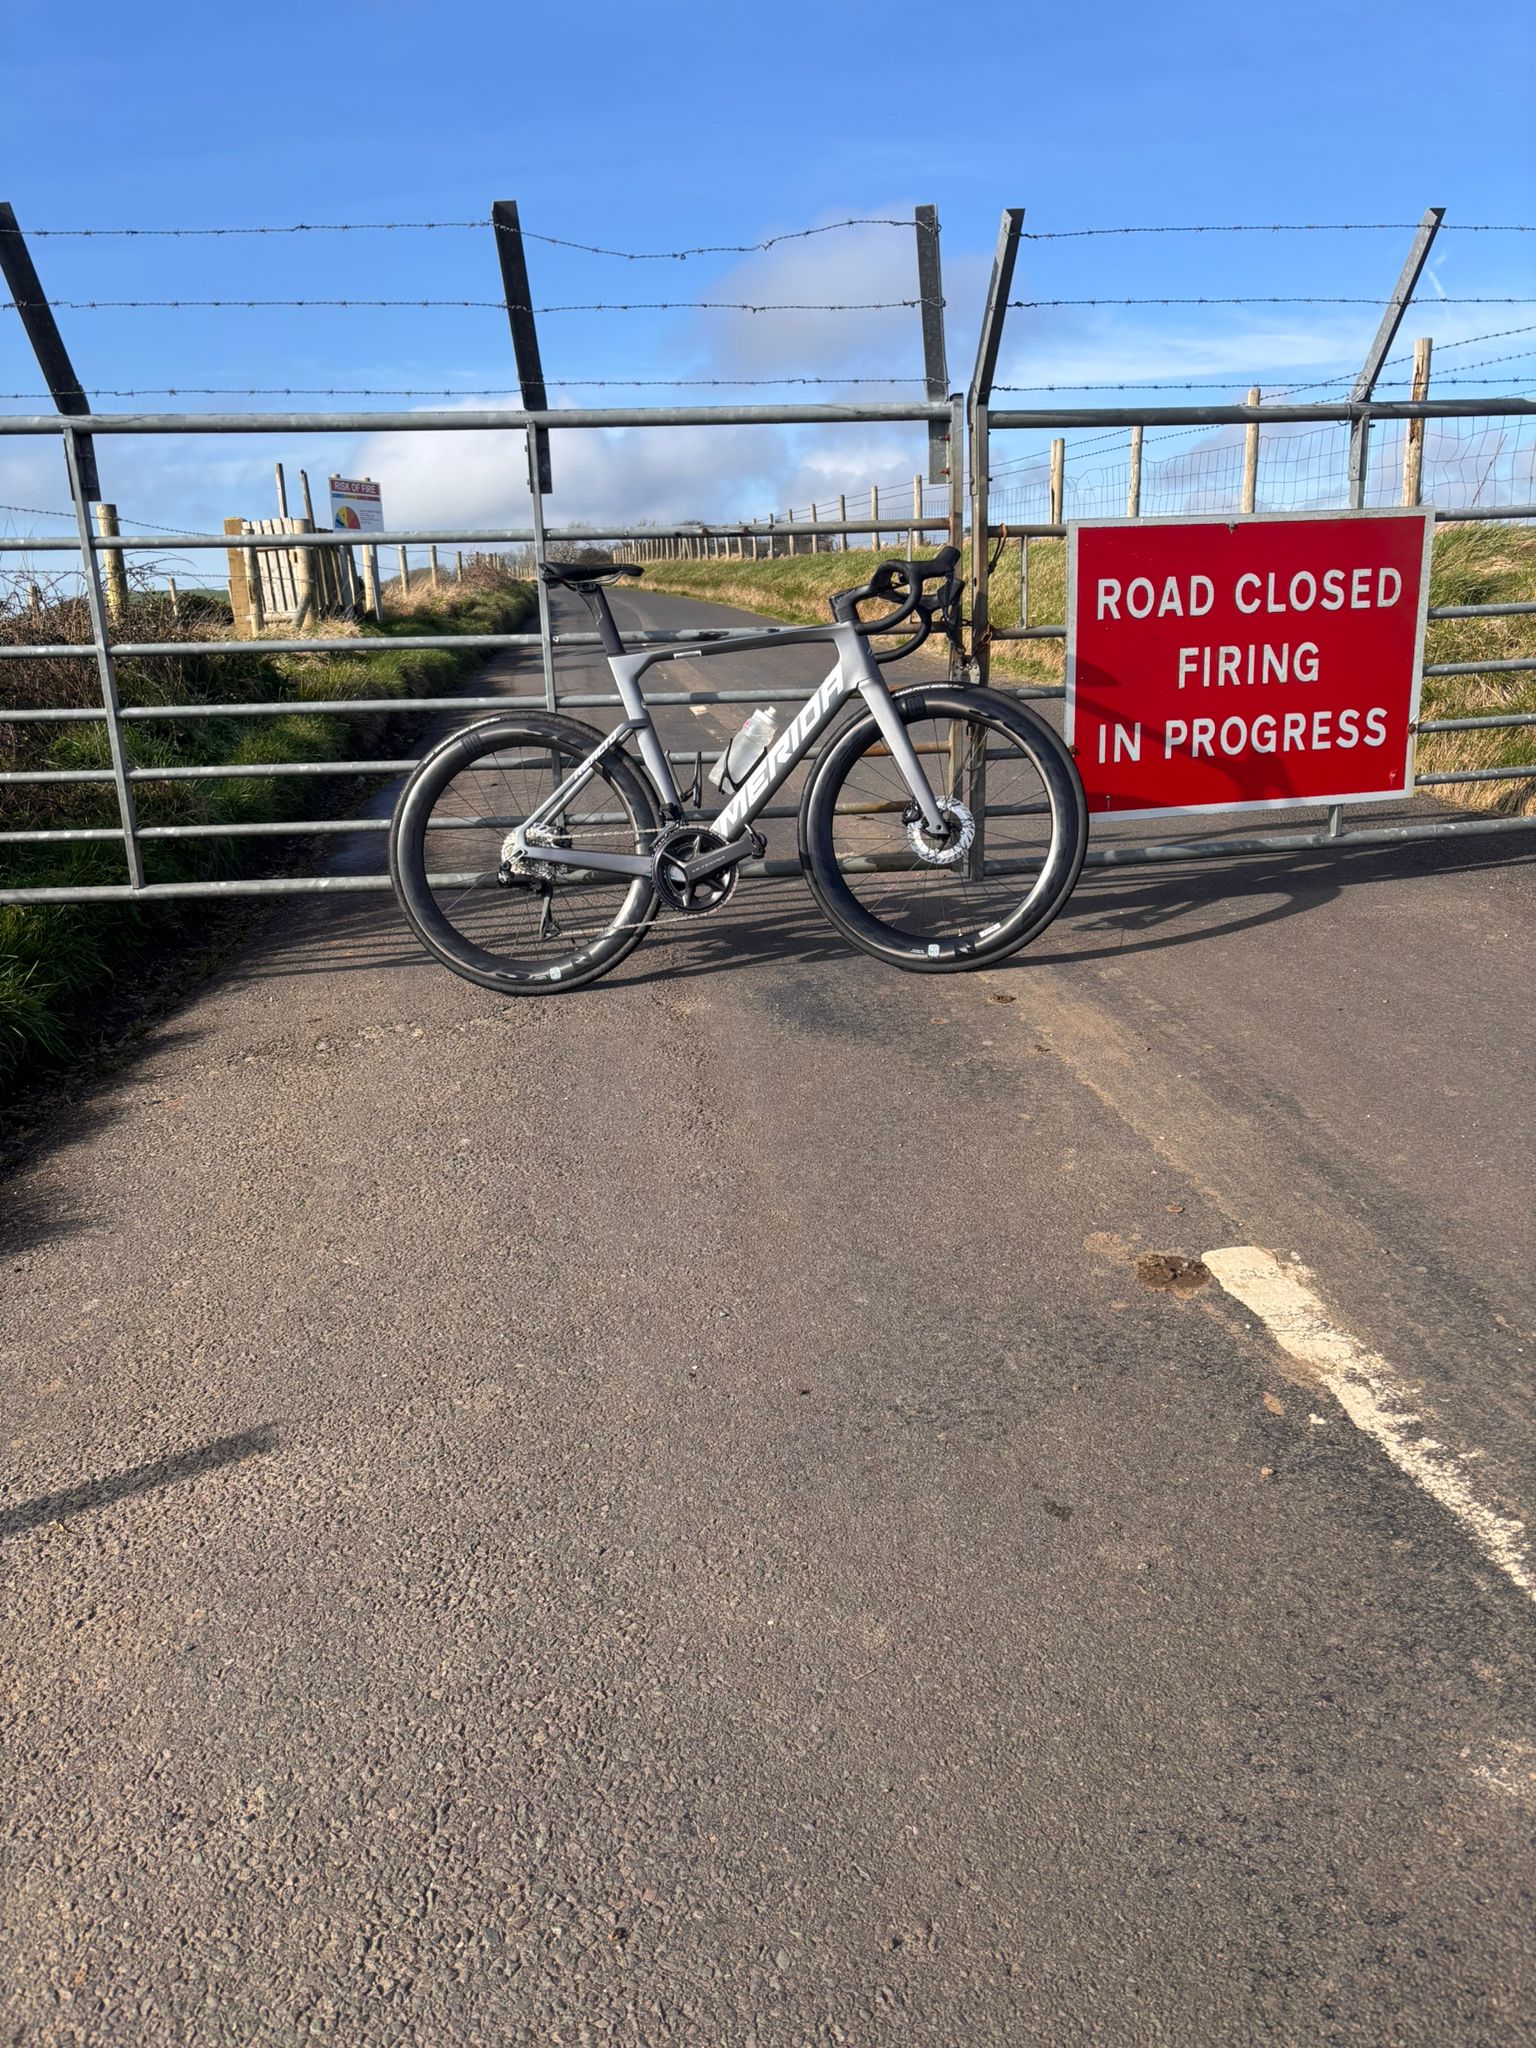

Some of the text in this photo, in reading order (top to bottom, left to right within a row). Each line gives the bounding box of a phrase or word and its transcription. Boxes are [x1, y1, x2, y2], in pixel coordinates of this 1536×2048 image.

[335, 481, 376, 494] RISK OF FIRE
[1097, 567, 1402, 620] ROAD CLOSED
[1178, 641, 1320, 689] FIRING
[710, 663, 844, 840] MERIDA
[1098, 707, 1389, 764] IN PROGRESS
